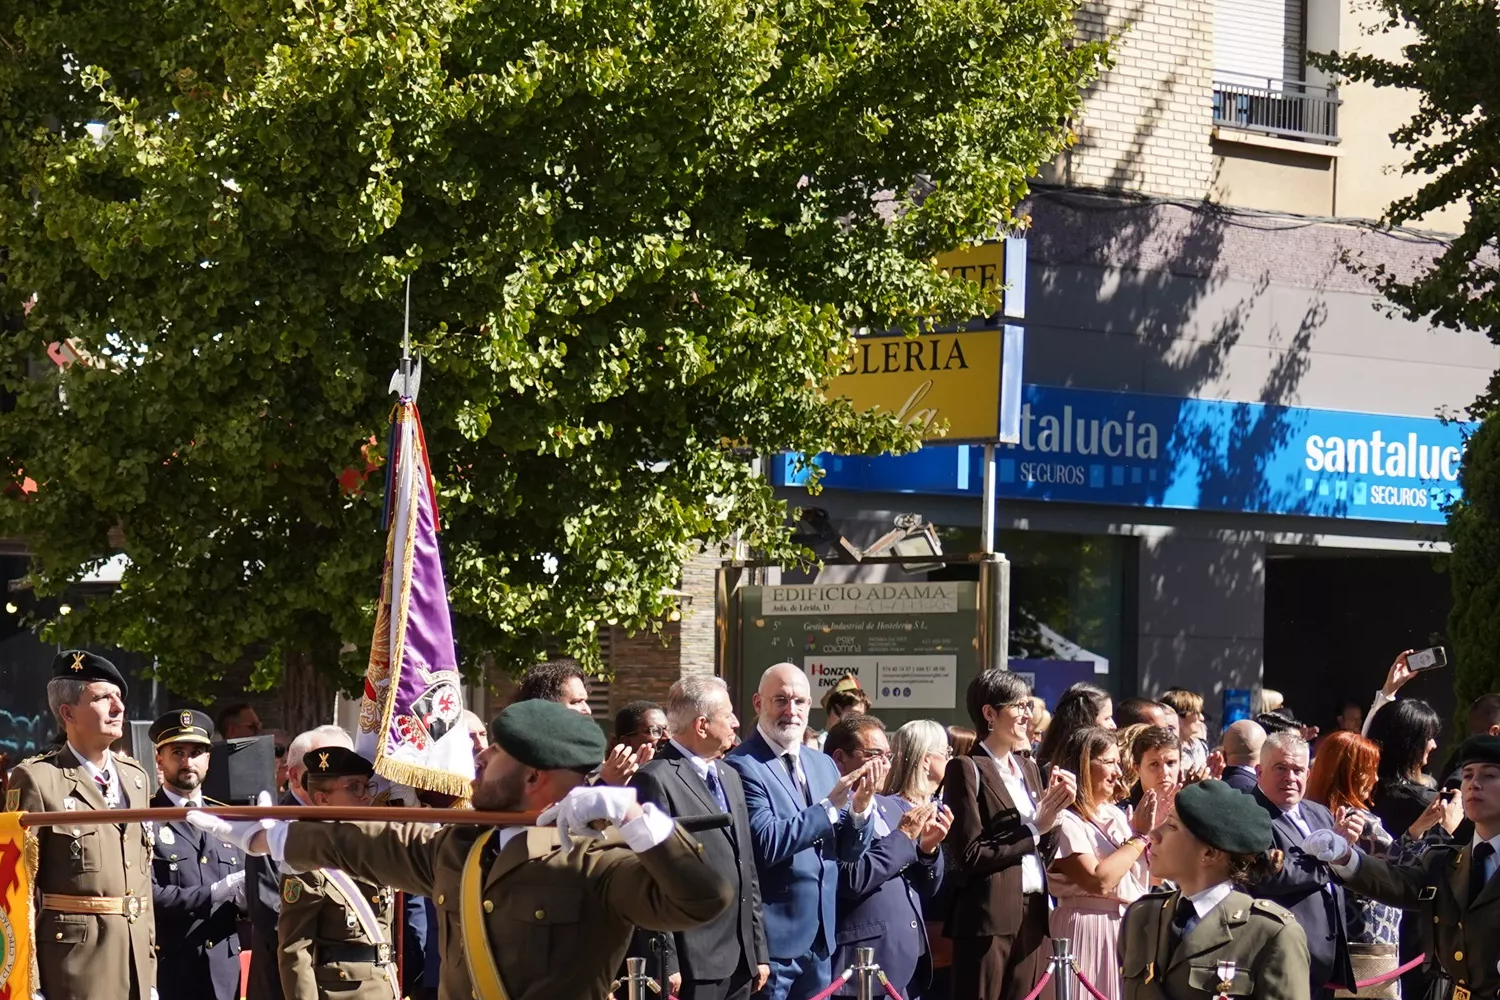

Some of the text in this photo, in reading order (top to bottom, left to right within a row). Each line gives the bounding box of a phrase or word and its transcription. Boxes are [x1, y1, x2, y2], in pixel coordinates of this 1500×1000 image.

[825, 338, 969, 375] ELERIA
[995, 404, 1158, 460] talucía
[1305, 430, 1468, 481] santaluc
[1020, 462, 1085, 485] SEGUROS
[1370, 485, 1427, 508] SEGUROS
[773, 585, 948, 602] EDIFICIO ADAMA
[829, 621, 864, 631] Industrial
[866, 621, 874, 630] de
[786, 638, 795, 648] A
[818, 678, 838, 687] ENG
